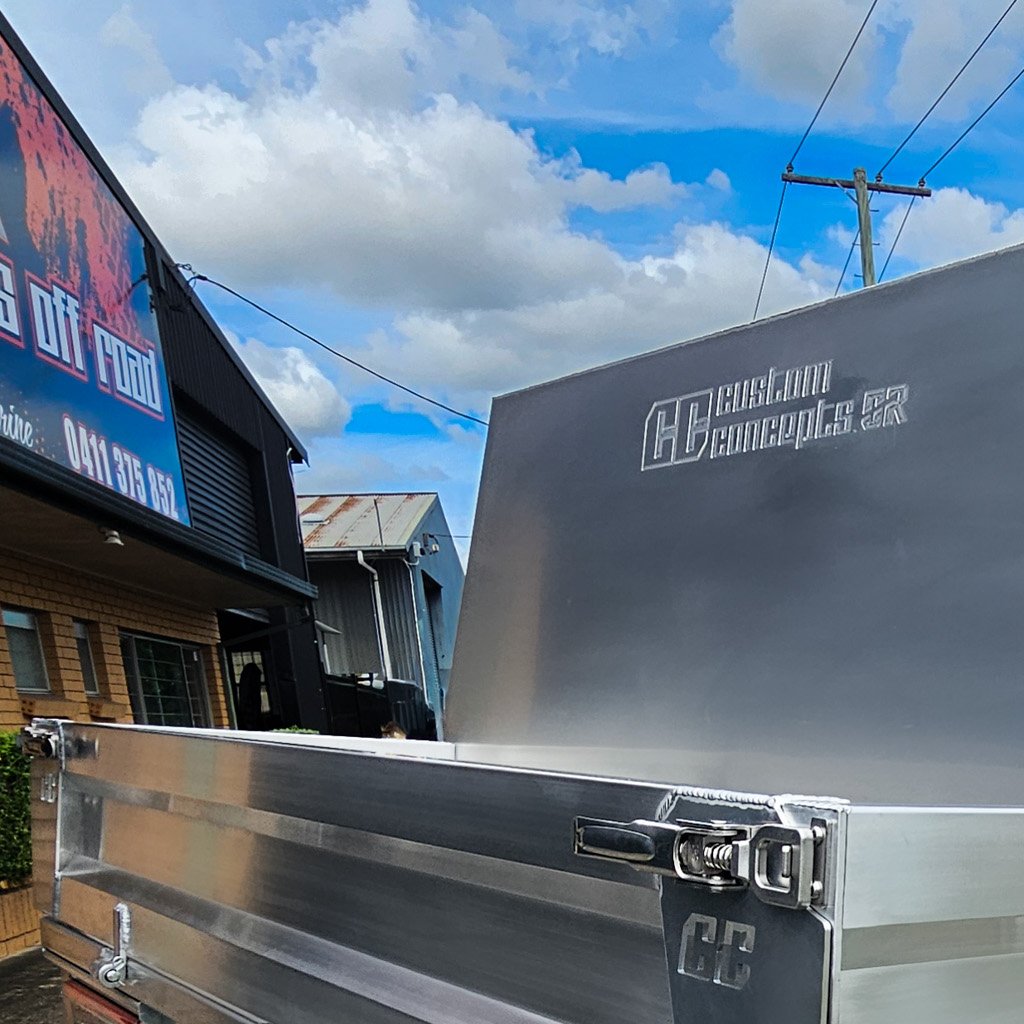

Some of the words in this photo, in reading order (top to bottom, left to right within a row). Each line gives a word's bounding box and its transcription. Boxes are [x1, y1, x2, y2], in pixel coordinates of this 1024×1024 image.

[28, 277, 85, 374] off
[92, 320, 163, 415] road
[716, 359, 833, 416] custom
[64, 416, 113, 486] 0411
[113, 445, 147, 502] 375
[147, 465, 179, 519] 852
[677, 912, 756, 990] CC
